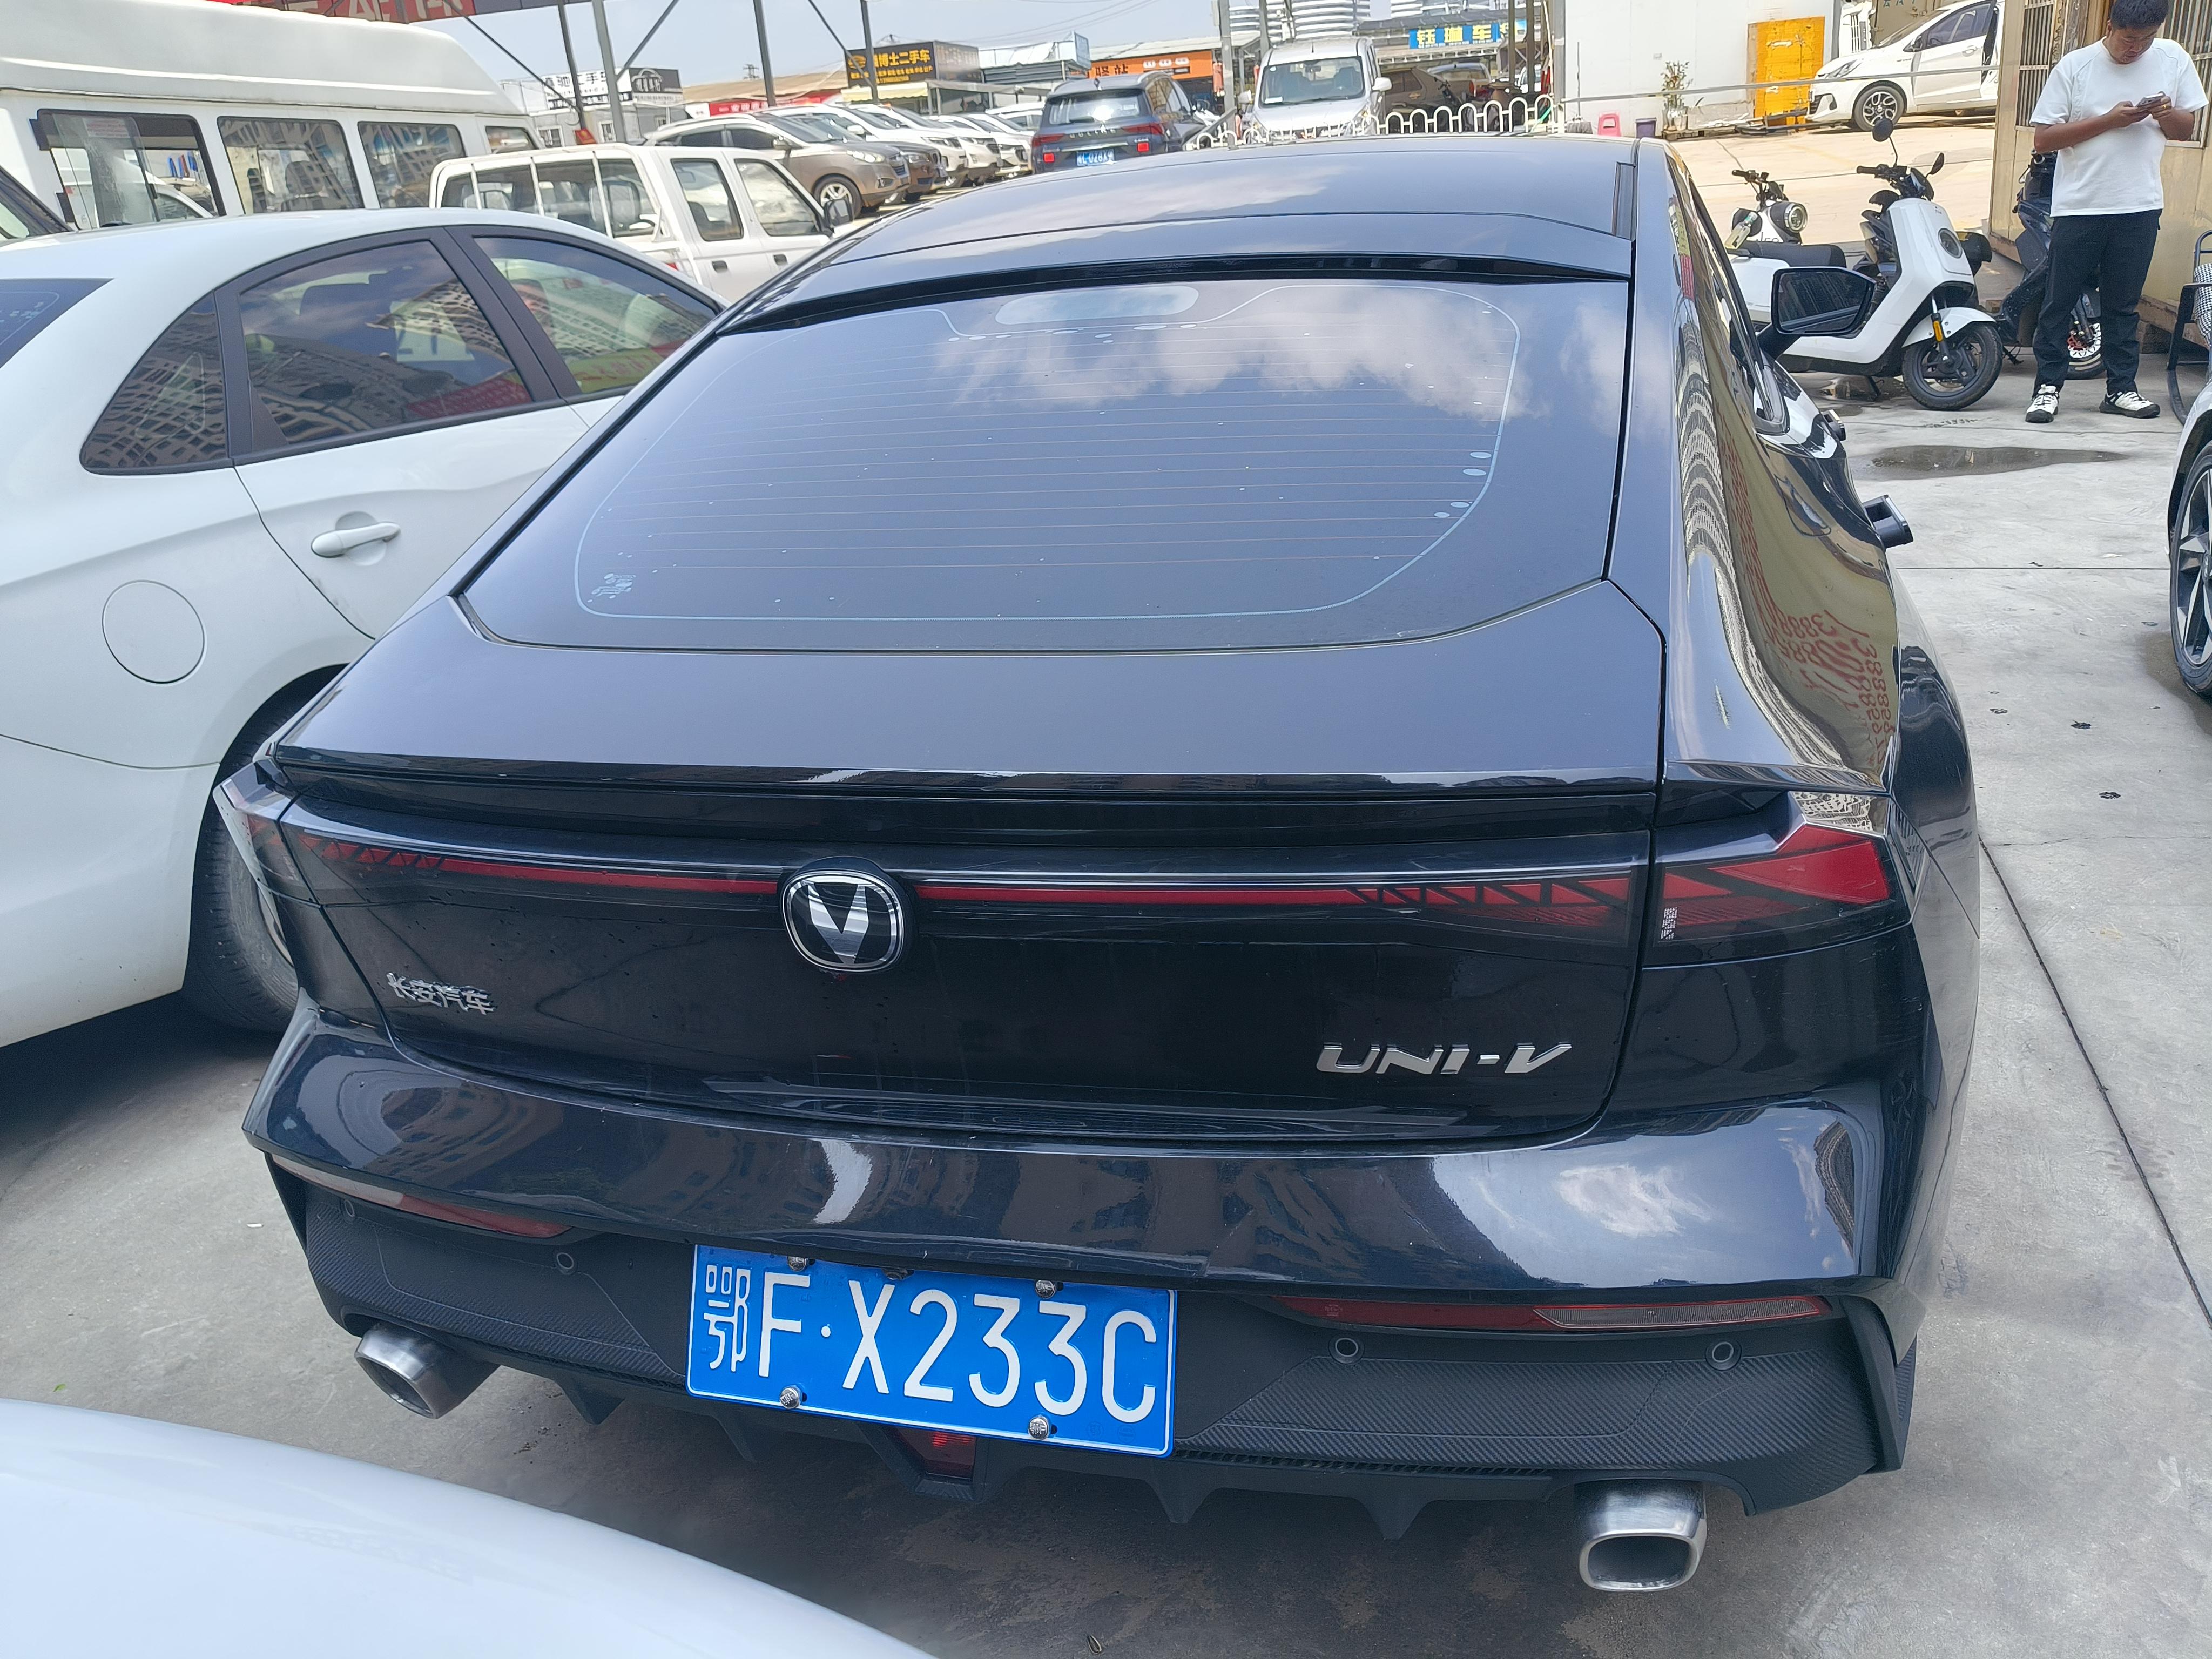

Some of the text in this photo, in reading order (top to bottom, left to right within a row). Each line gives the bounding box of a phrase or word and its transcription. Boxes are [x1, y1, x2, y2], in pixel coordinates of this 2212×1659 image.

[386, 972, 496, 1015] 长安汽车
[1316, 1043, 1573, 1075] UNI-V
[703, 1265, 1157, 1424] 鄂F·X233C
